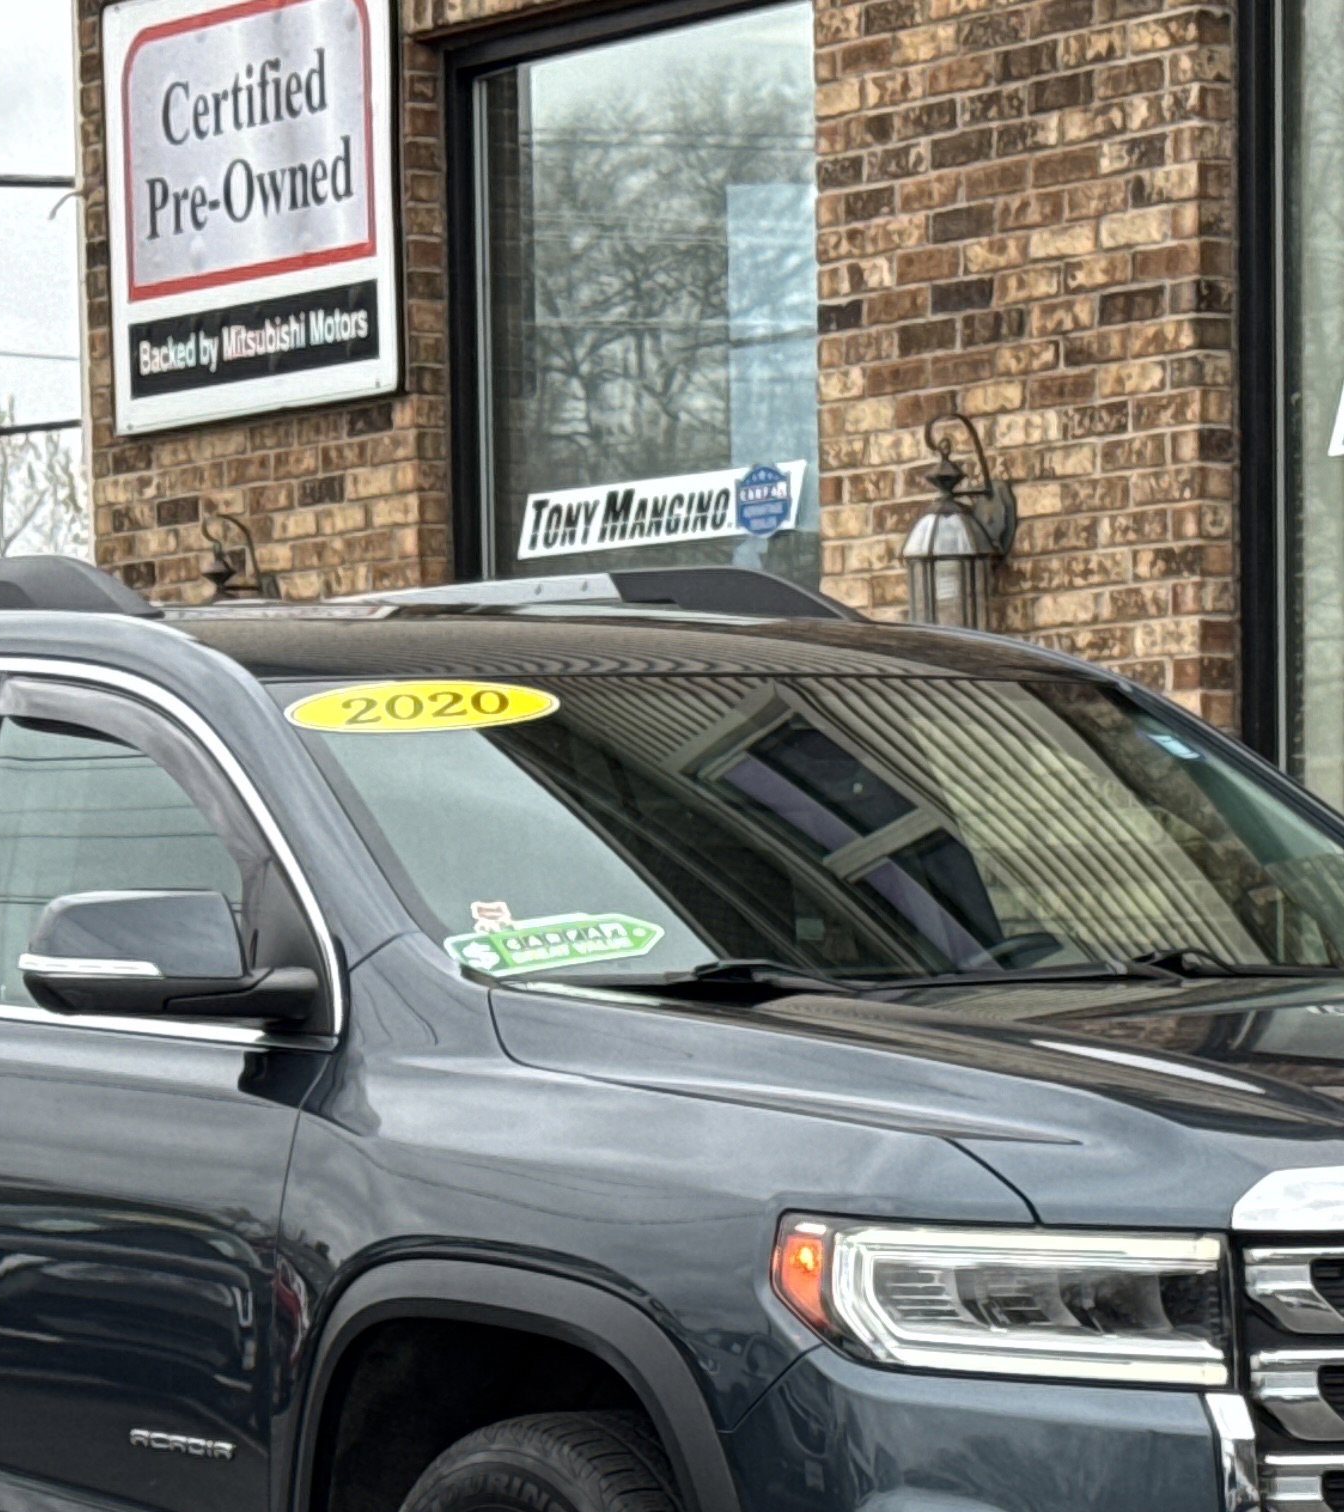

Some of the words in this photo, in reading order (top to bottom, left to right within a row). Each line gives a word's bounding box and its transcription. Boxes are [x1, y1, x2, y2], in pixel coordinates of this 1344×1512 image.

[161, 47, 328, 146] Certified
[146, 135, 354, 241] Pre-Owned
[139, 334, 196, 375] Backed
[199, 330, 218, 373] by
[222, 311, 306, 361] Mitsubishi
[309, 308, 369, 346] Motors
[528, 499, 599, 550] TONY
[342, 690, 509, 725] 2020
